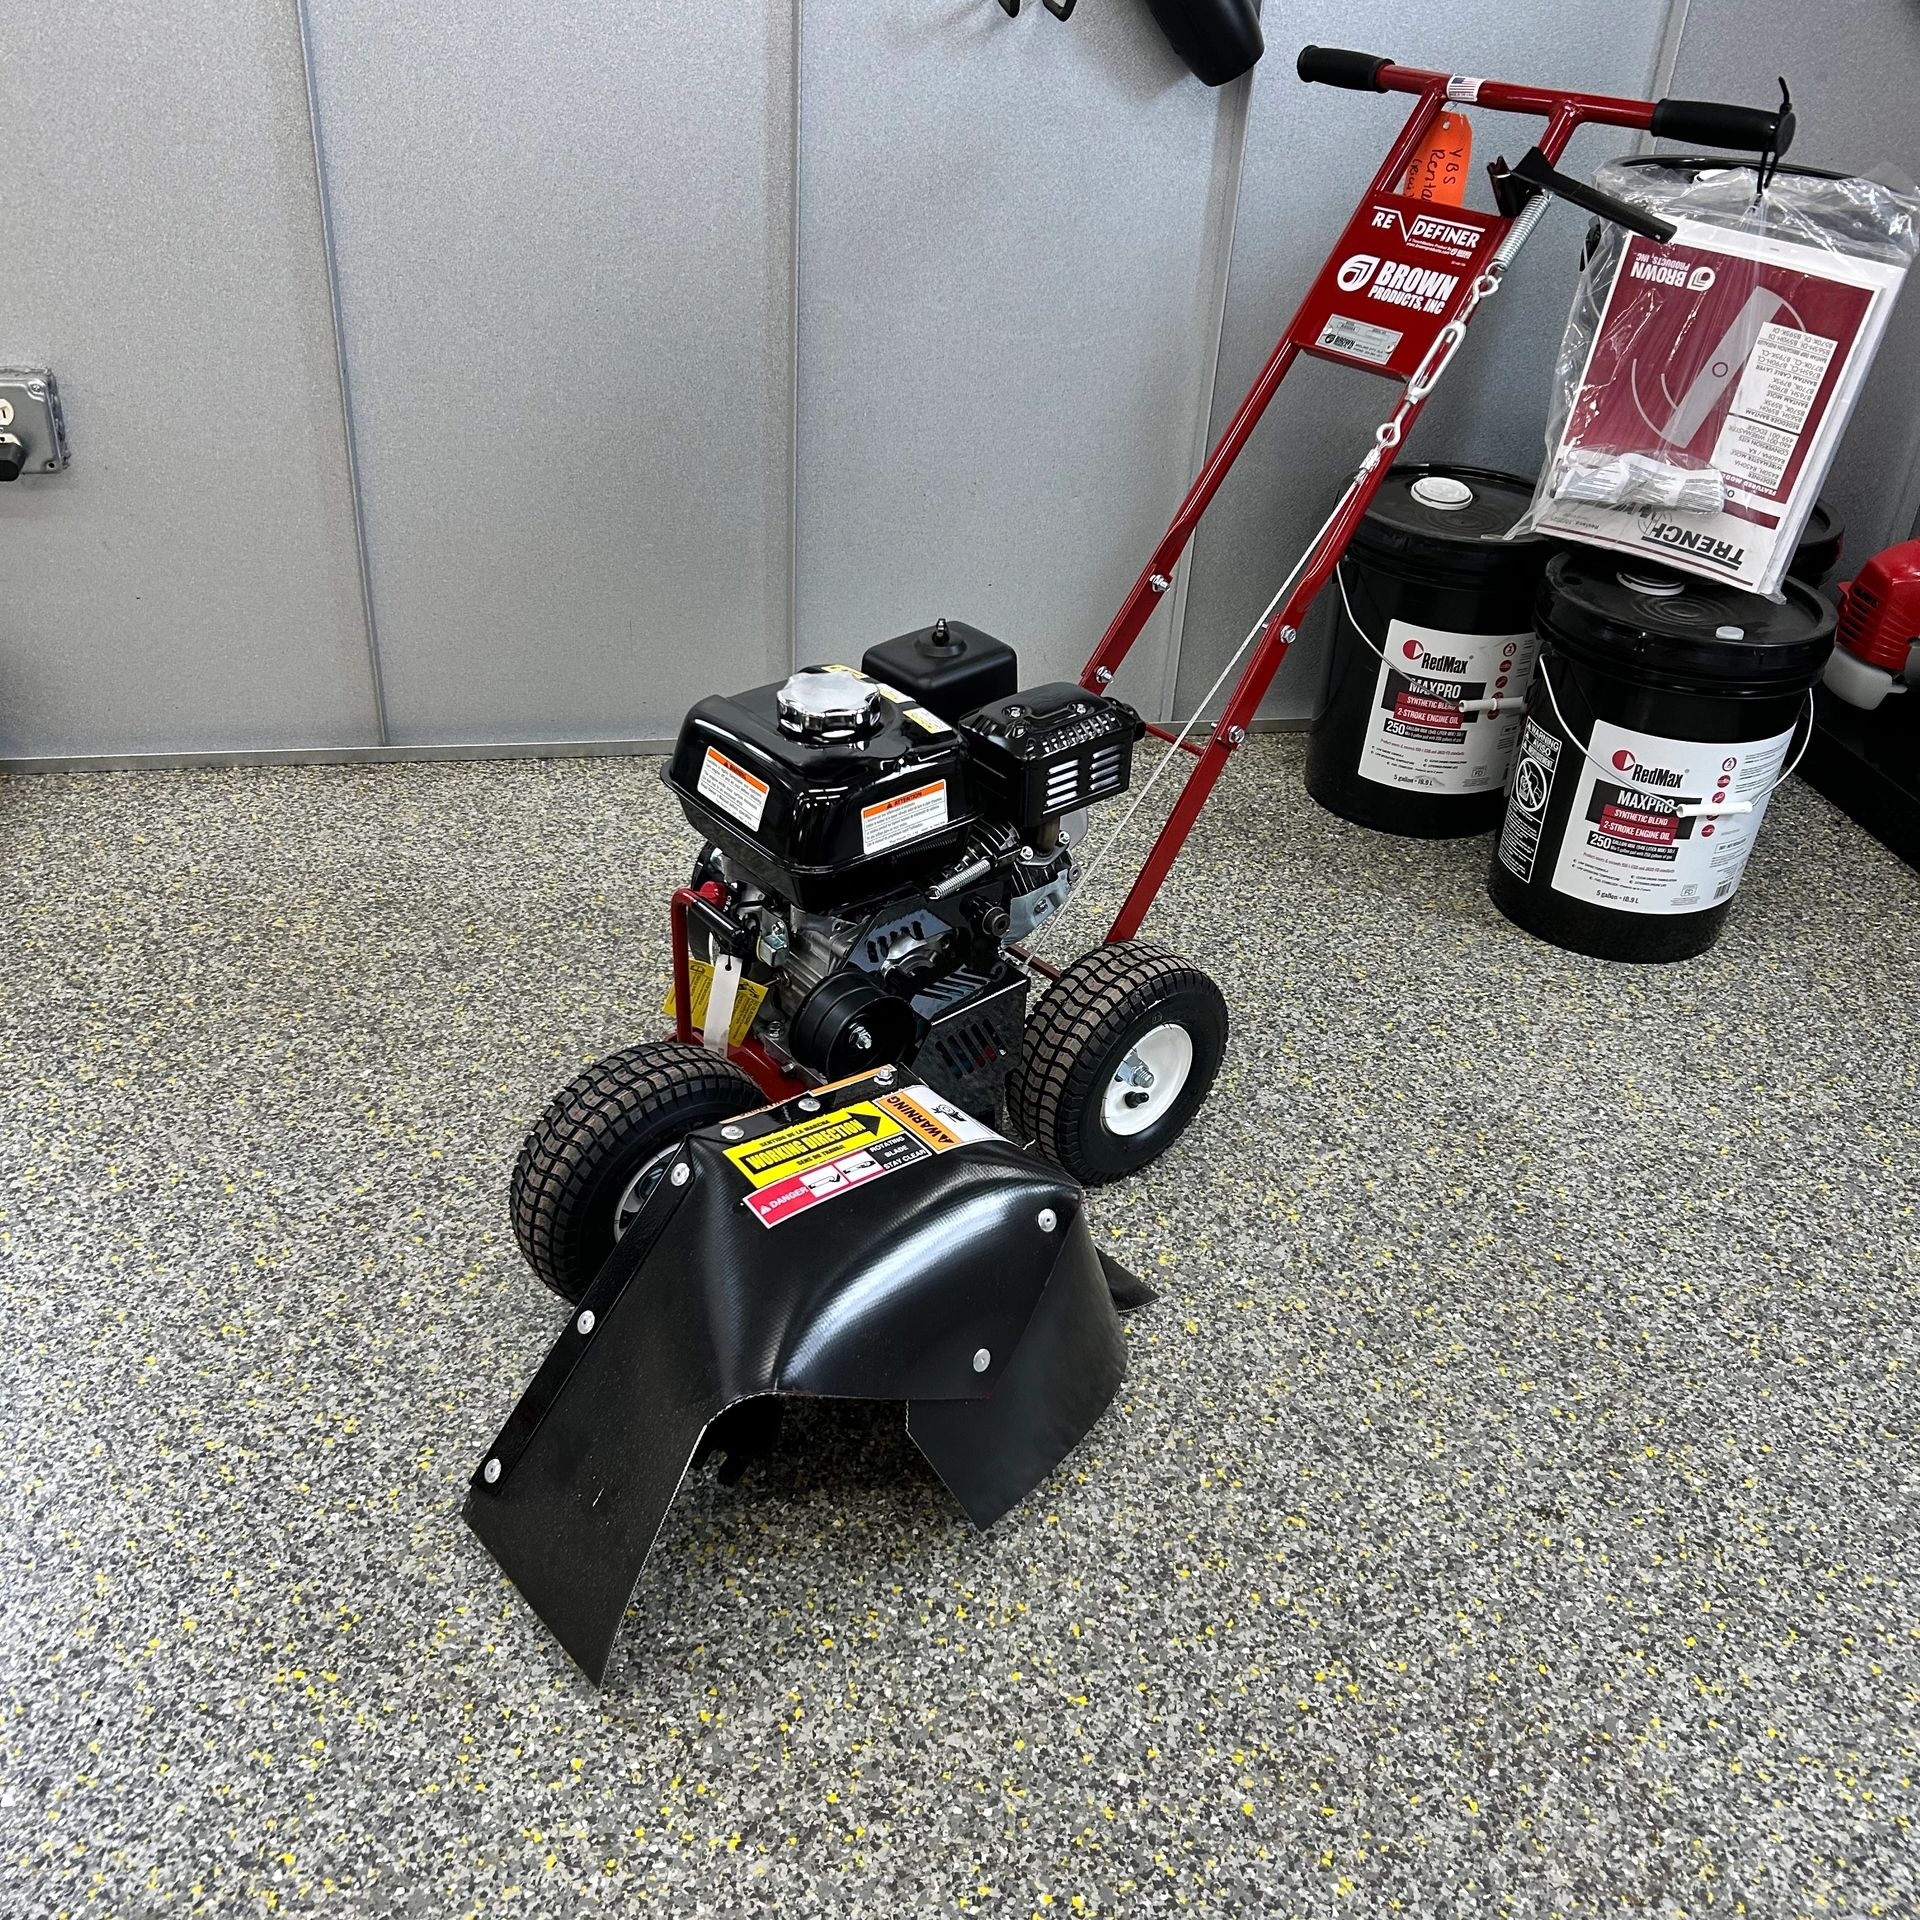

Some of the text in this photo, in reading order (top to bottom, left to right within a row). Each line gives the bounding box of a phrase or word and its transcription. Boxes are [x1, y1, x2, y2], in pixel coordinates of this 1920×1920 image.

[1372, 212, 1480, 248] RE DEFINER
[1649, 253, 1691, 270] PRODUCTS,
[1375, 260, 1460, 301] BROWN
[1629, 261, 1687, 287] BROWN
[1368, 284, 1445, 314] PRODUCTS, INC
[1773, 369, 1791, 378] CABLE
[1792, 375, 1817, 386] BANTAM
[1766, 391, 1808, 408] BANTAM MOLE
[1744, 409, 1769, 420] BANTAM
[1746, 424, 1767, 435] EDGER
[1737, 435, 1788, 457] CONVERSION KITS
[1742, 478, 1776, 497] FEATURED
[1648, 519, 1746, 566] TRENCH
[1421, 652, 1468, 674] RedMax
[1409, 677, 1461, 699] MAXPRO
[1407, 696, 1437, 708] SYNTHETIC
[1398, 708, 1458, 724] 2-STROKE ENGINE OIL
[1386, 720, 1405, 735] 250
[1532, 724, 1559, 752] WARNING
[1533, 739, 1551, 758] AVISO
[1632, 764, 1683, 788] RedMax
[1614, 810, 1668, 826] SYNTHETIC BLEND
[1603, 820, 1670, 841] 2-STROKE ENGINE OIL
[1590, 834, 1611, 849] 250
[887, 1096, 942, 1137] WARNING
[746, 1119, 866, 1170] WORKING DIRECTION
[870, 1136, 905, 1153] ROTATING
[884, 1144, 909, 1158] BLADE
[883, 1149, 927, 1170] STAY CLEAR
[769, 1186, 809, 1208] DANGER
